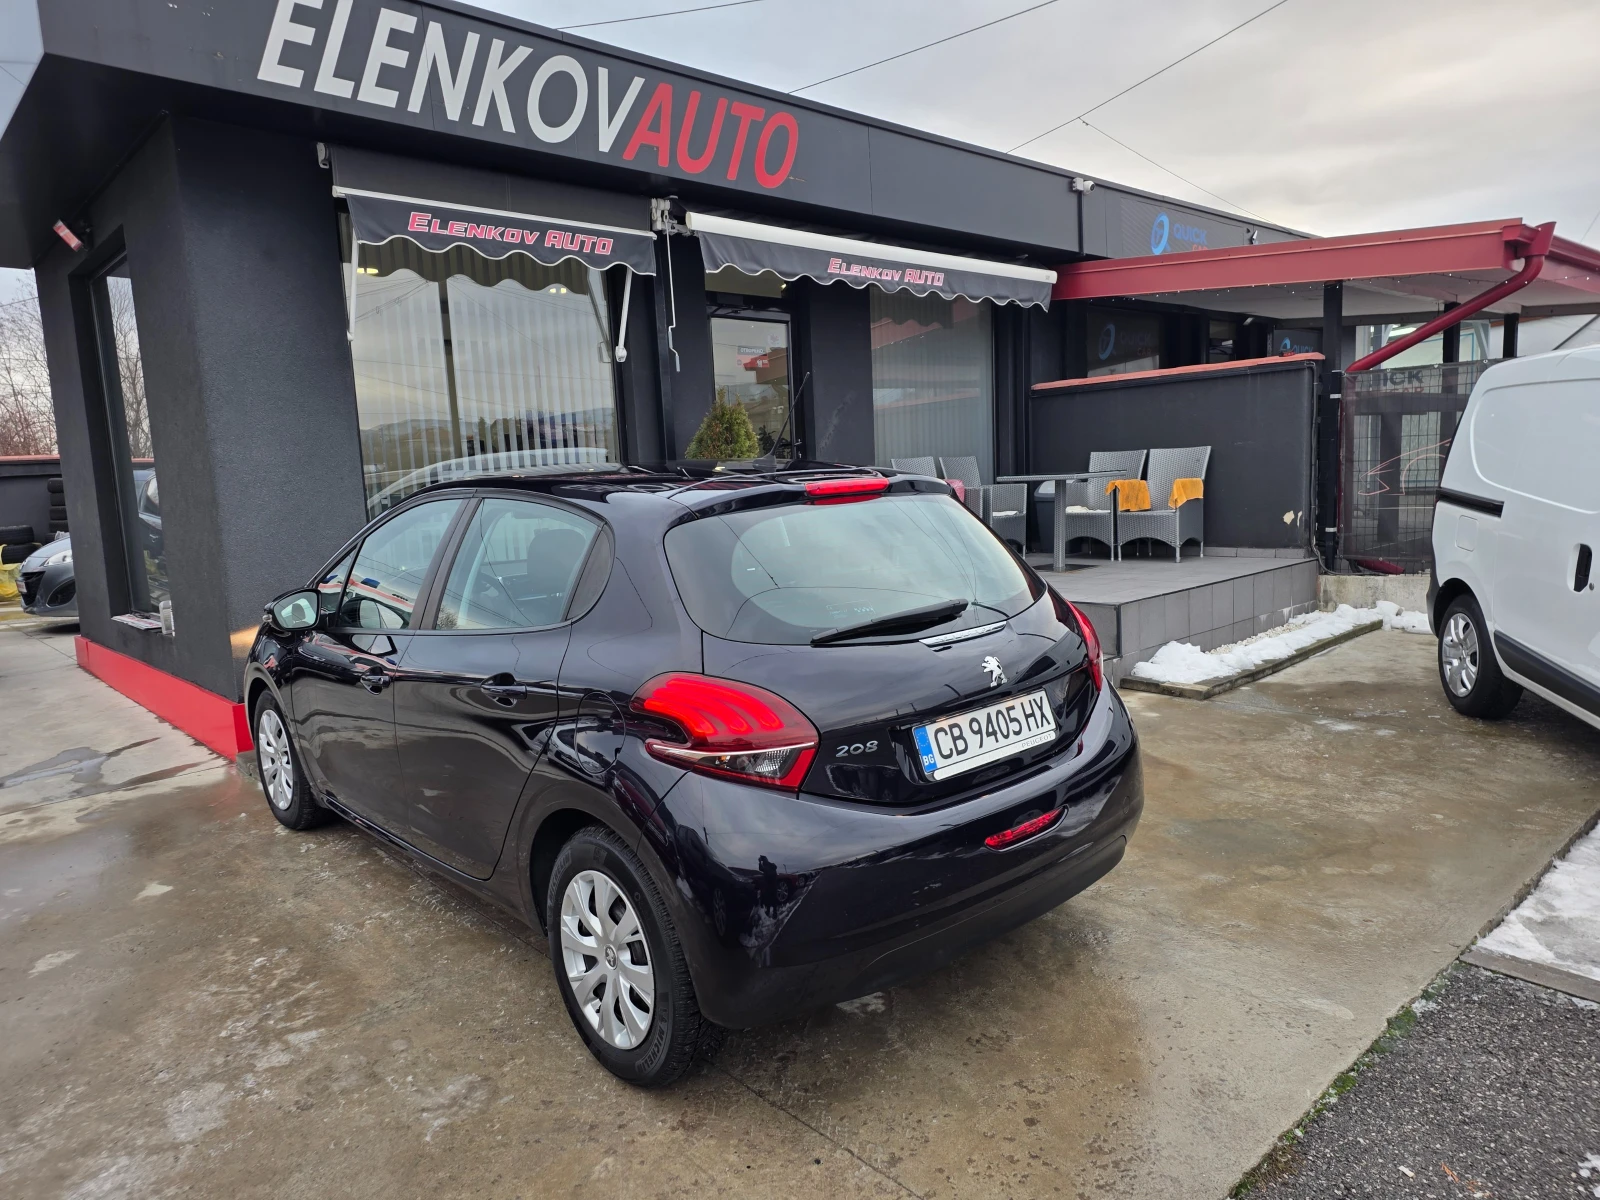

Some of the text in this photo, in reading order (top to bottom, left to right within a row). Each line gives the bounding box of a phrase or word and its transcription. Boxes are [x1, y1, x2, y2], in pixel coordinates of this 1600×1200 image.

[407, 211, 613, 256] ELENKOV AUTO
[1173, 223, 1208, 245] QUICK
[827, 257, 945, 287] ELENKOV AUTO
[933, 696, 1051, 760] CB 9405 HX
[835, 740, 879, 758] 208
[1021, 733, 1053, 749] PEUGEOT
[922, 753, 935, 766] BG
